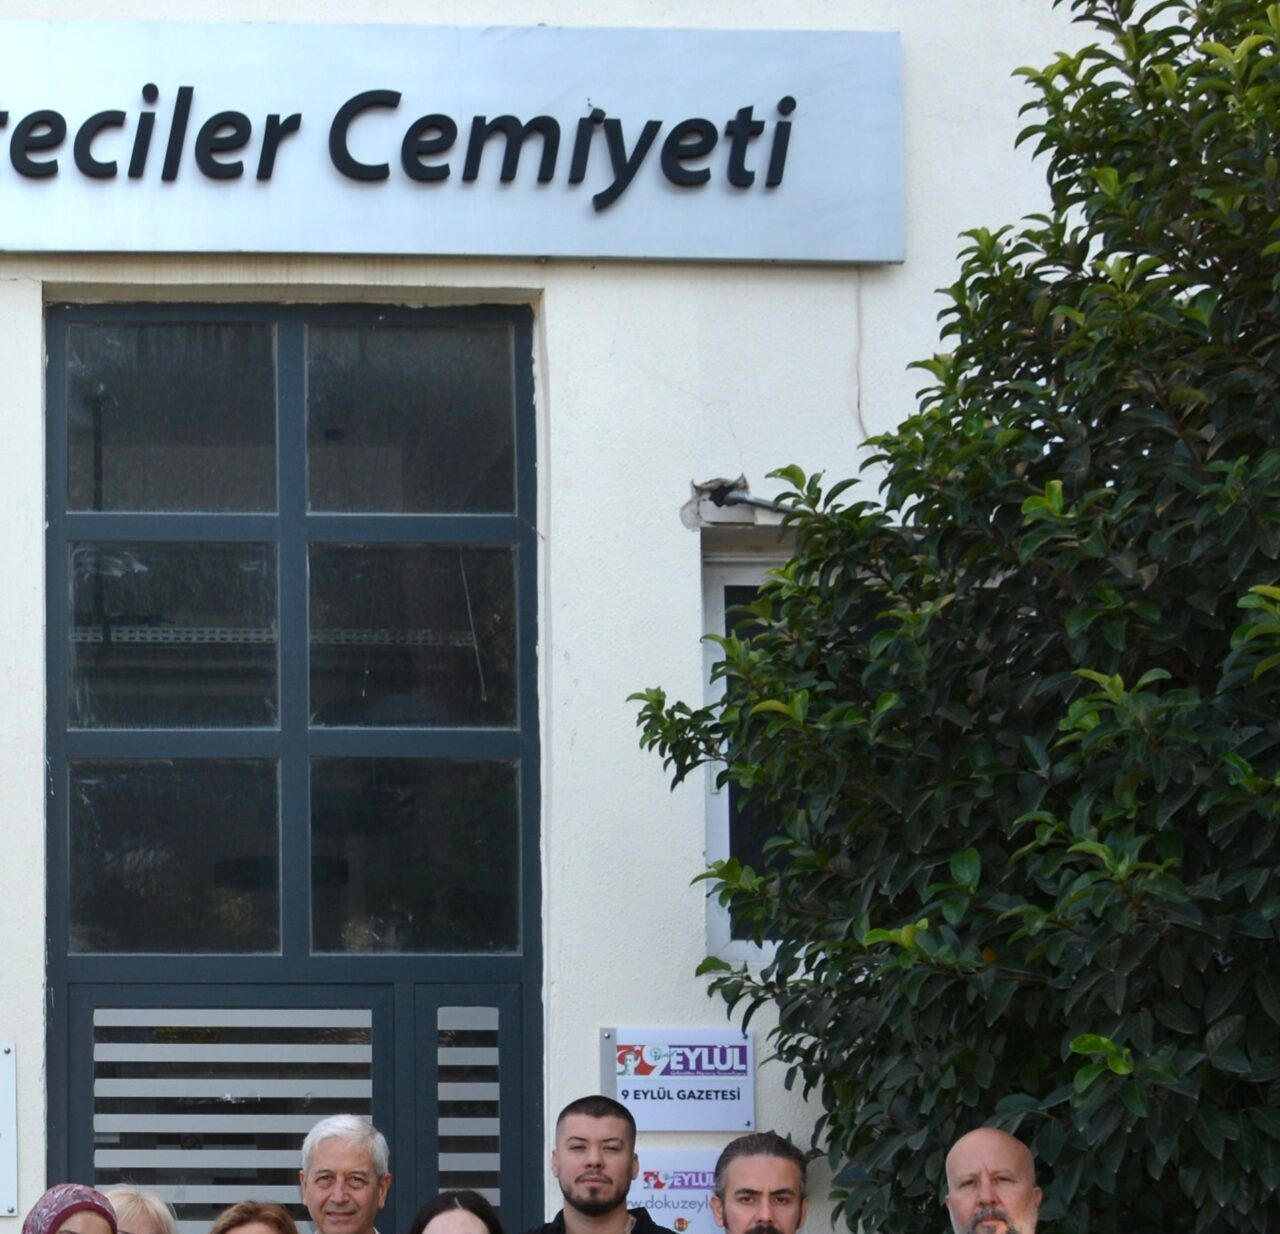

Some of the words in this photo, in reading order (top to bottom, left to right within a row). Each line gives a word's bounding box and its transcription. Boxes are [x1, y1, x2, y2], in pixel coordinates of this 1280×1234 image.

[329, 89, 797, 213] Cemiyeti
[621, 1090, 629, 1101] 9
[634, 1087, 673, 1101] EYLÜL
[677, 1087, 741, 1101] GAZETESİ
